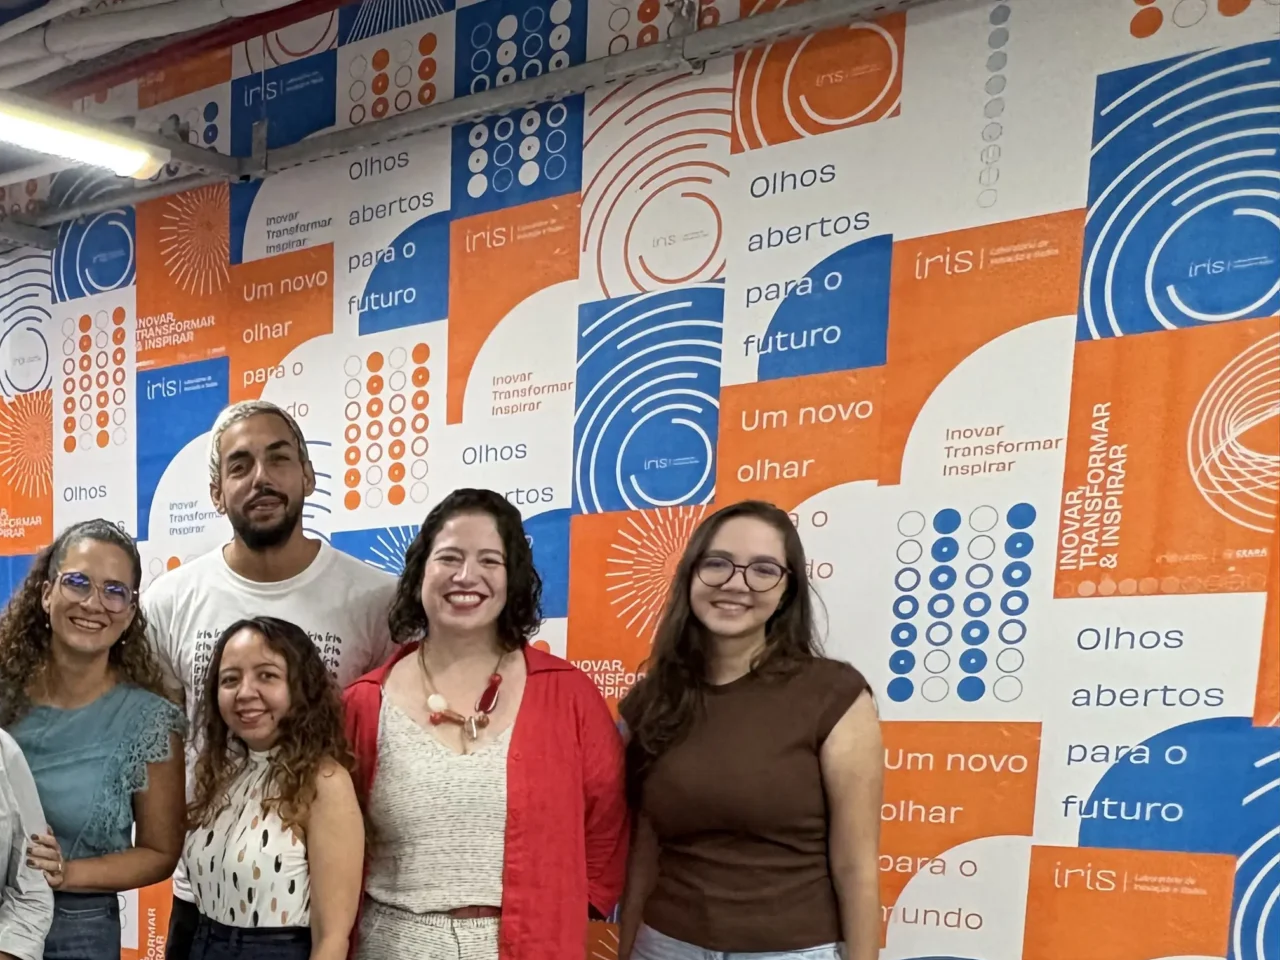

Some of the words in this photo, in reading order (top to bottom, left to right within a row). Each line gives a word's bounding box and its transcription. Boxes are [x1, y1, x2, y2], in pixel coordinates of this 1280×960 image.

[349, 151, 410, 181] Olhos
[750, 163, 836, 199] Olhos
[348, 190, 434, 227] abertos
[466, 226, 506, 253] iris
[748, 211, 870, 252] abertos
[347, 245, 396, 273] para
[403, 241, 416, 259] o
[914, 248, 974, 280] iris
[243, 283, 275, 302] Um
[280, 269, 328, 294] novo
[745, 277, 813, 308] para
[824, 271, 842, 291] o
[347, 287, 416, 315] futuro
[242, 320, 293, 344] olhar
[743, 323, 842, 357] futuro
[147, 373, 177, 399] iris
[243, 366, 286, 388] para
[292, 360, 304, 376] o
[492, 371, 534, 386] Inovar
[491, 380, 574, 402] Transformar
[491, 400, 543, 416] Inspirar
[742, 409, 788, 431] Um
[799, 400, 873, 426] novo
[945, 424, 1004, 441] Inovar
[462, 442, 528, 466] Olhos
[944, 438, 1063, 459] Transformar
[737, 459, 815, 483] olhar
[942, 460, 1016, 477] Inspirar
[63, 484, 107, 502] Olhos
[1079, 401, 1111, 571] TRANSFORMAR
[1102, 443, 1128, 549] INSPIRAR
[1059, 485, 1088, 570] INOVAR,
[1099, 555, 1118, 569] &
[1076, 627, 1184, 651] Olhos
[1071, 684, 1225, 708] abertos
[884, 747, 934, 772] Um
[946, 753, 1028, 774] novo
[1067, 743, 1151, 766] para
[1165, 745, 1187, 765] o
[880, 800, 964, 825] olhar
[1062, 795, 1184, 822] futuro
[959, 859, 978, 877] o
[1054, 862, 1117, 892] iris
